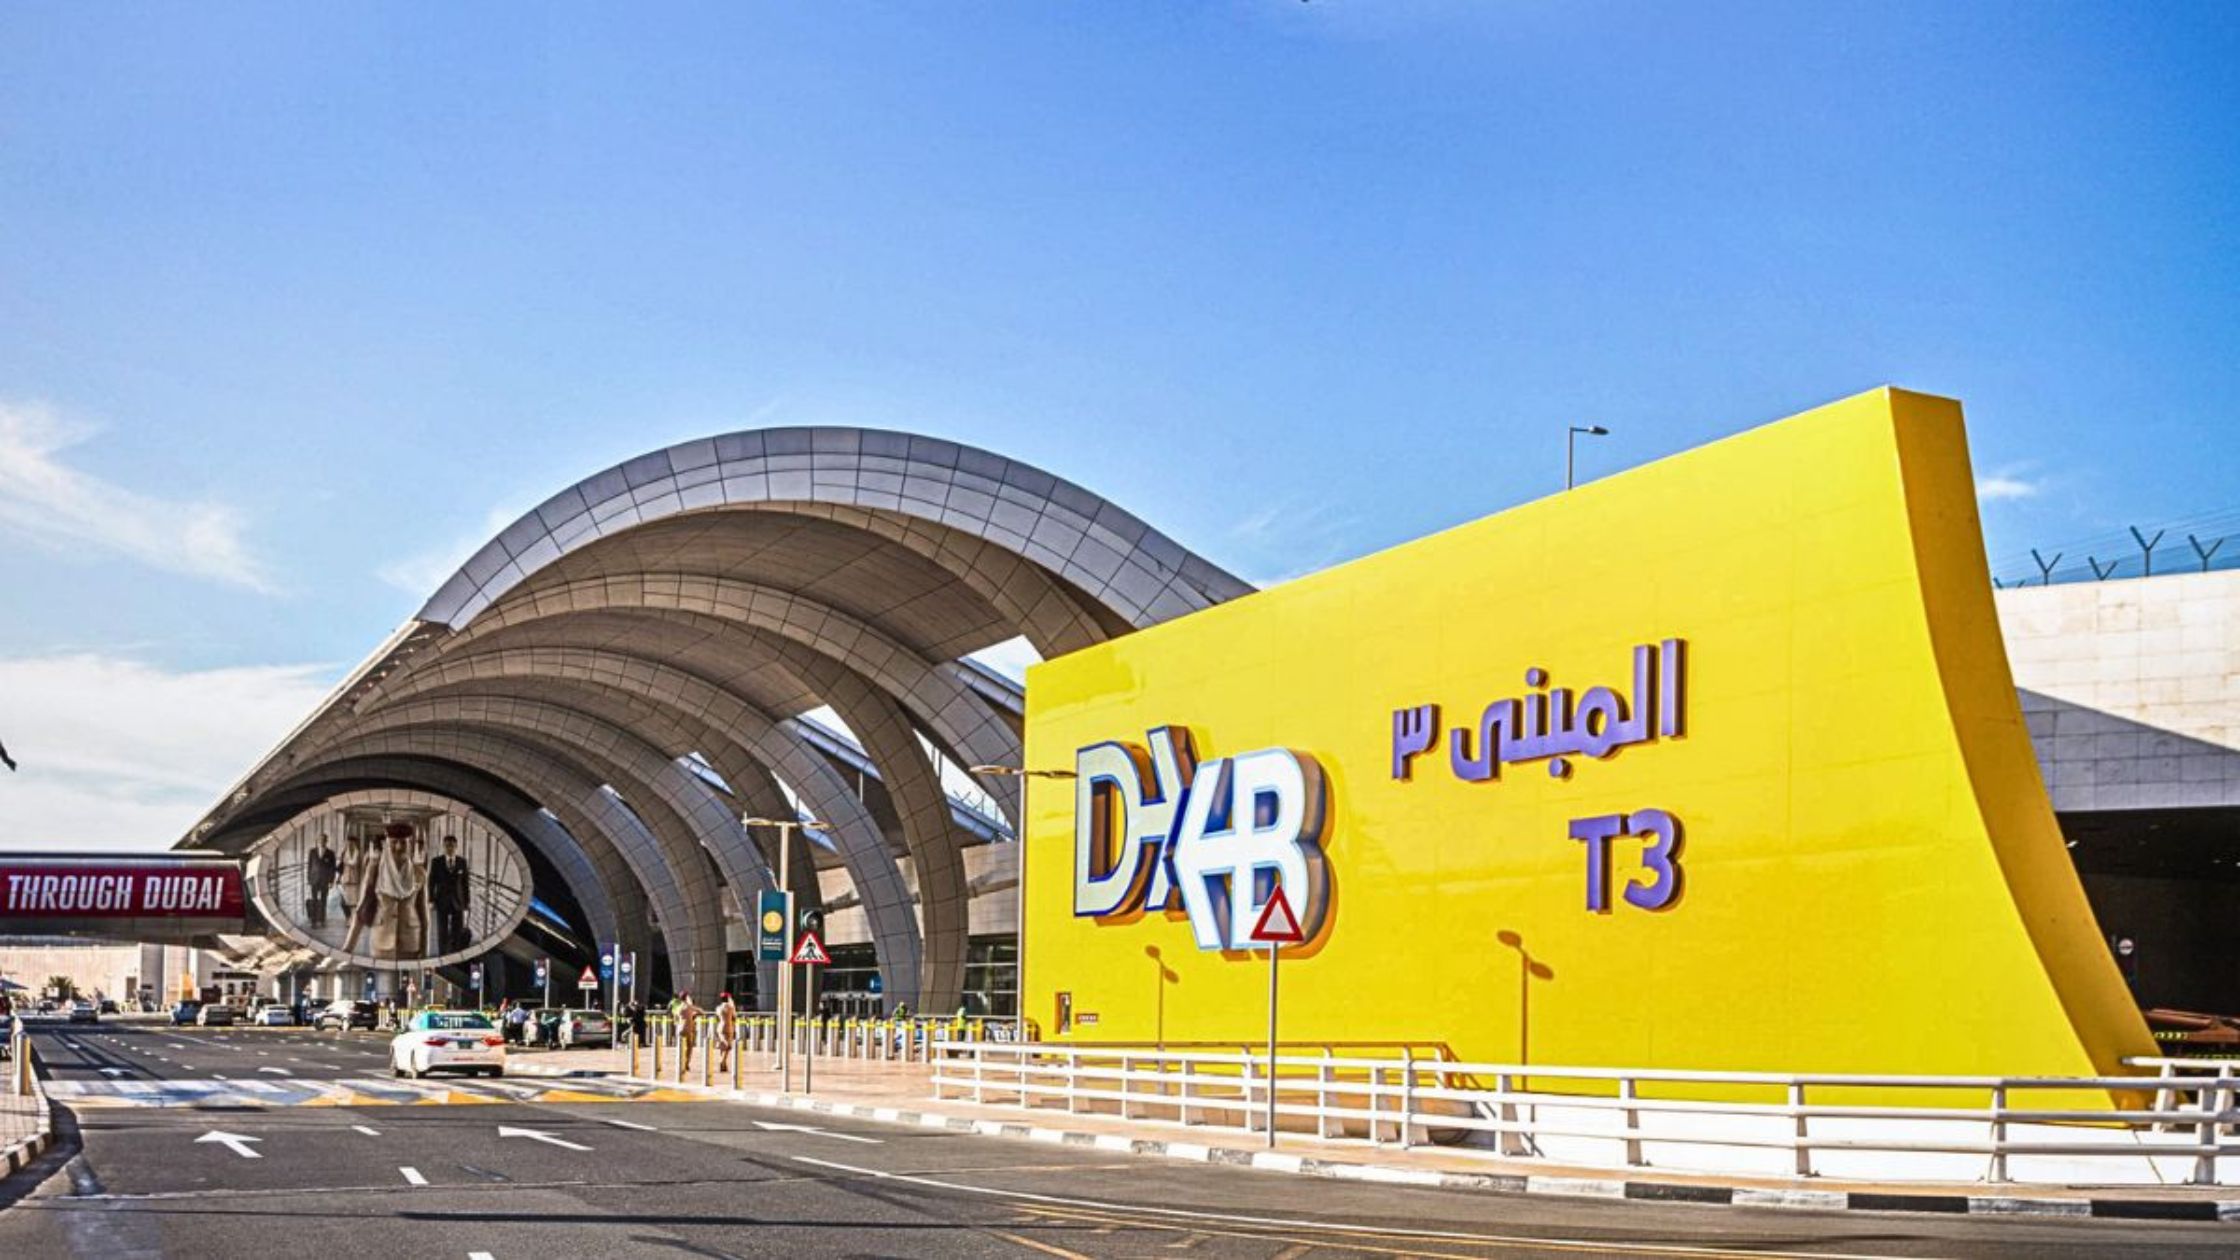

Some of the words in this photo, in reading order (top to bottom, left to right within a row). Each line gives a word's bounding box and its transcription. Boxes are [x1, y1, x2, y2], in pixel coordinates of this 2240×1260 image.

[1391, 703, 1440, 781] ٣
[1451, 638, 1687, 783] المبنى
[7, 875, 134, 911] THROUGH
[142, 876, 225, 910] DUBAI
[1569, 807, 1686, 913] T3
